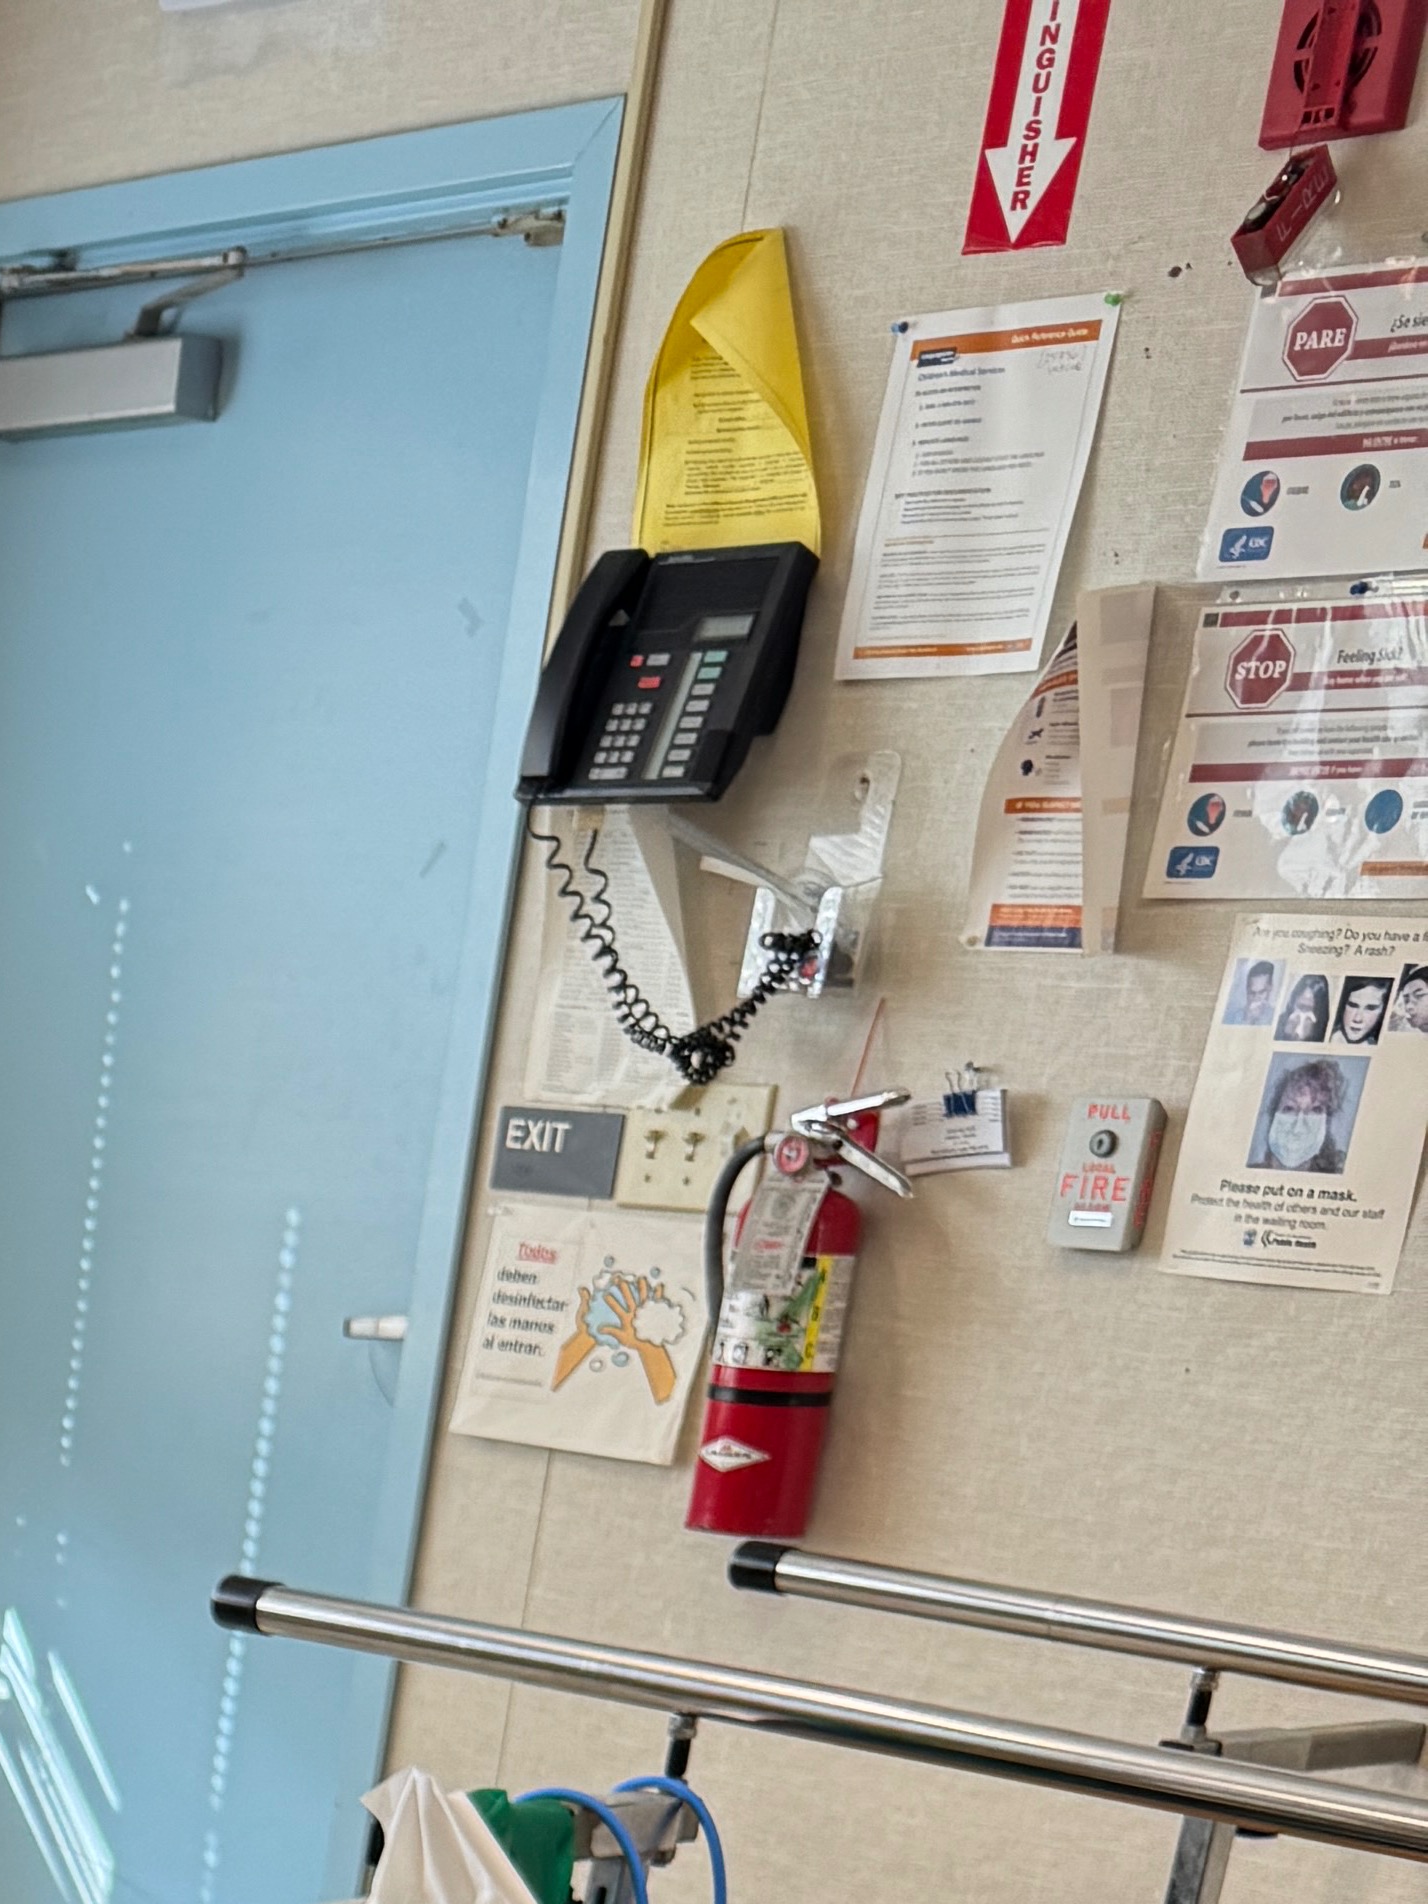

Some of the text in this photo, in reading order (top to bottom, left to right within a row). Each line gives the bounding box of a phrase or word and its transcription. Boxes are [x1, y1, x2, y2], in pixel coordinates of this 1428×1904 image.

[1275, 165, 1330, 242] FIRE
[1293, 327, 1348, 352] PARE
[1336, 648, 1376, 666] Feeling
[1234, 659, 1287, 681] STOP
[1344, 928, 1360, 940] Do
[1361, 930, 1382, 943] you
[1383, 929, 1410, 942] have
[1412, 933, 1421, 942] a
[1354, 945, 1363, 956] A
[1363, 945, 1396, 957] rash?
[1086, 1103, 1131, 1122] PULL
[505, 1117, 573, 1153] EXIT
[1059, 1172, 1131, 1202] FIRE
[1219, 1178, 1358, 1202] Please put on a mask.
[496, 1265, 538, 1285] deben
[491, 1289, 568, 1313] desinfectar
[487, 1311, 556, 1335] las manos
